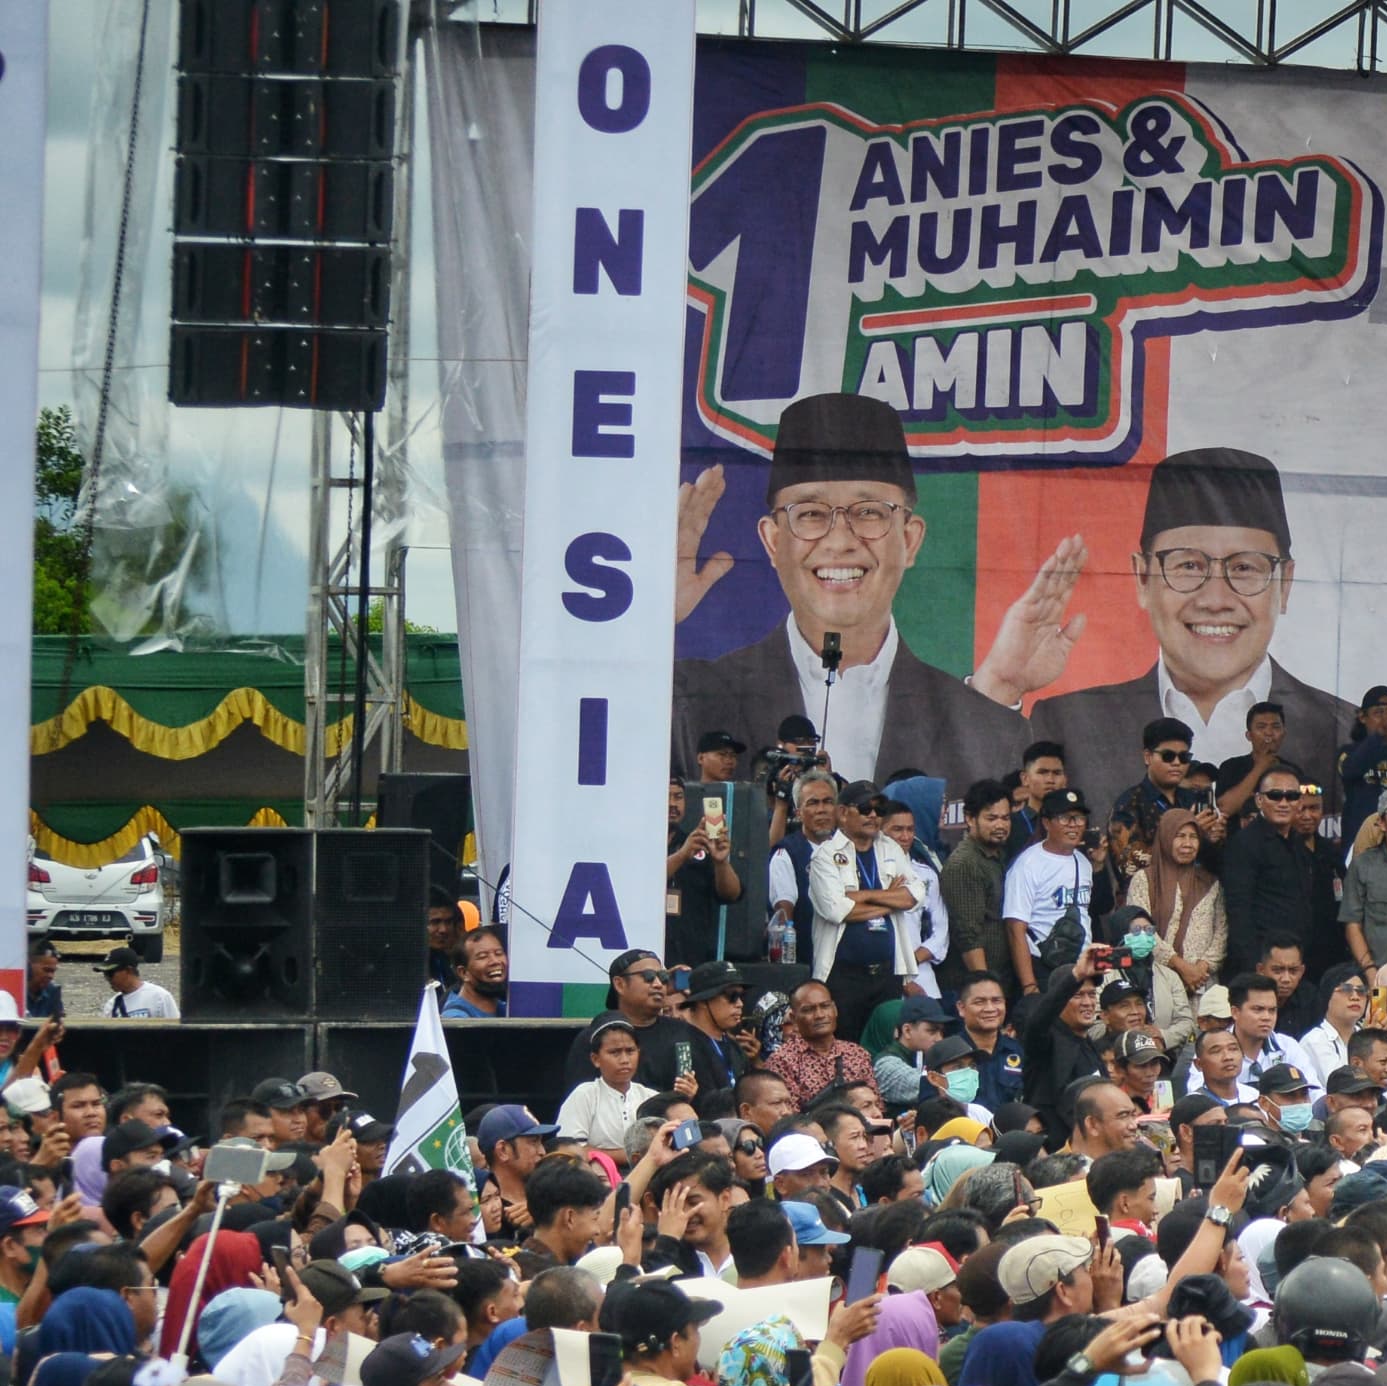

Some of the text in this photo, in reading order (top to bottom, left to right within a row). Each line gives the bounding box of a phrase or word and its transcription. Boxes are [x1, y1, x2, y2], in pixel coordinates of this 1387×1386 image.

[848, 101, 1185, 212] ANIES &
[847, 165, 1320, 284] MUHAIMIN
[857, 321, 1088, 411] AMIN
[1314, 1329, 1348, 1339] HONDA
